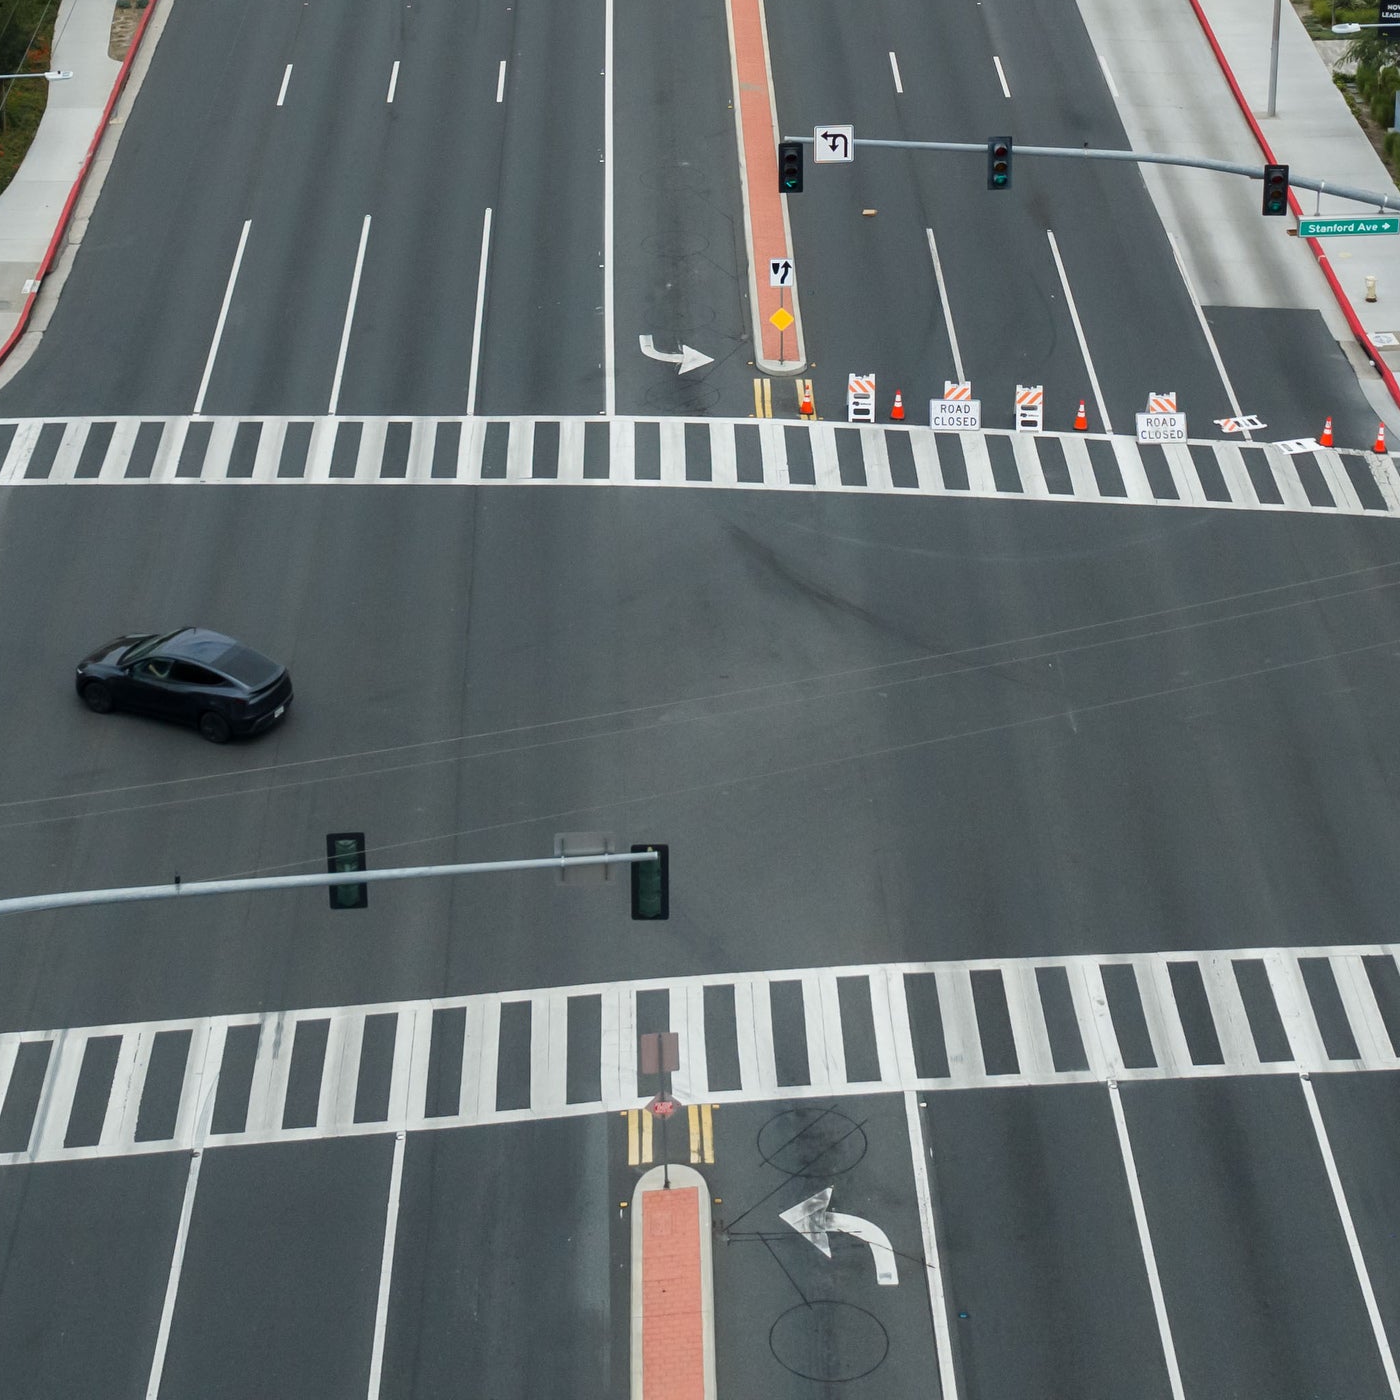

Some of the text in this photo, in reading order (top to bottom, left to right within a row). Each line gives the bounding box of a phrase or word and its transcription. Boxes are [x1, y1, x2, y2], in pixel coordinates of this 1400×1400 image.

[1308, 222, 1378, 233] Stanford Ave
[940, 404, 971, 414] ROAD
[933, 416, 977, 427] CLOSED
[1146, 417, 1177, 428] ROAD
[1140, 429, 1185, 440] CLOSED
